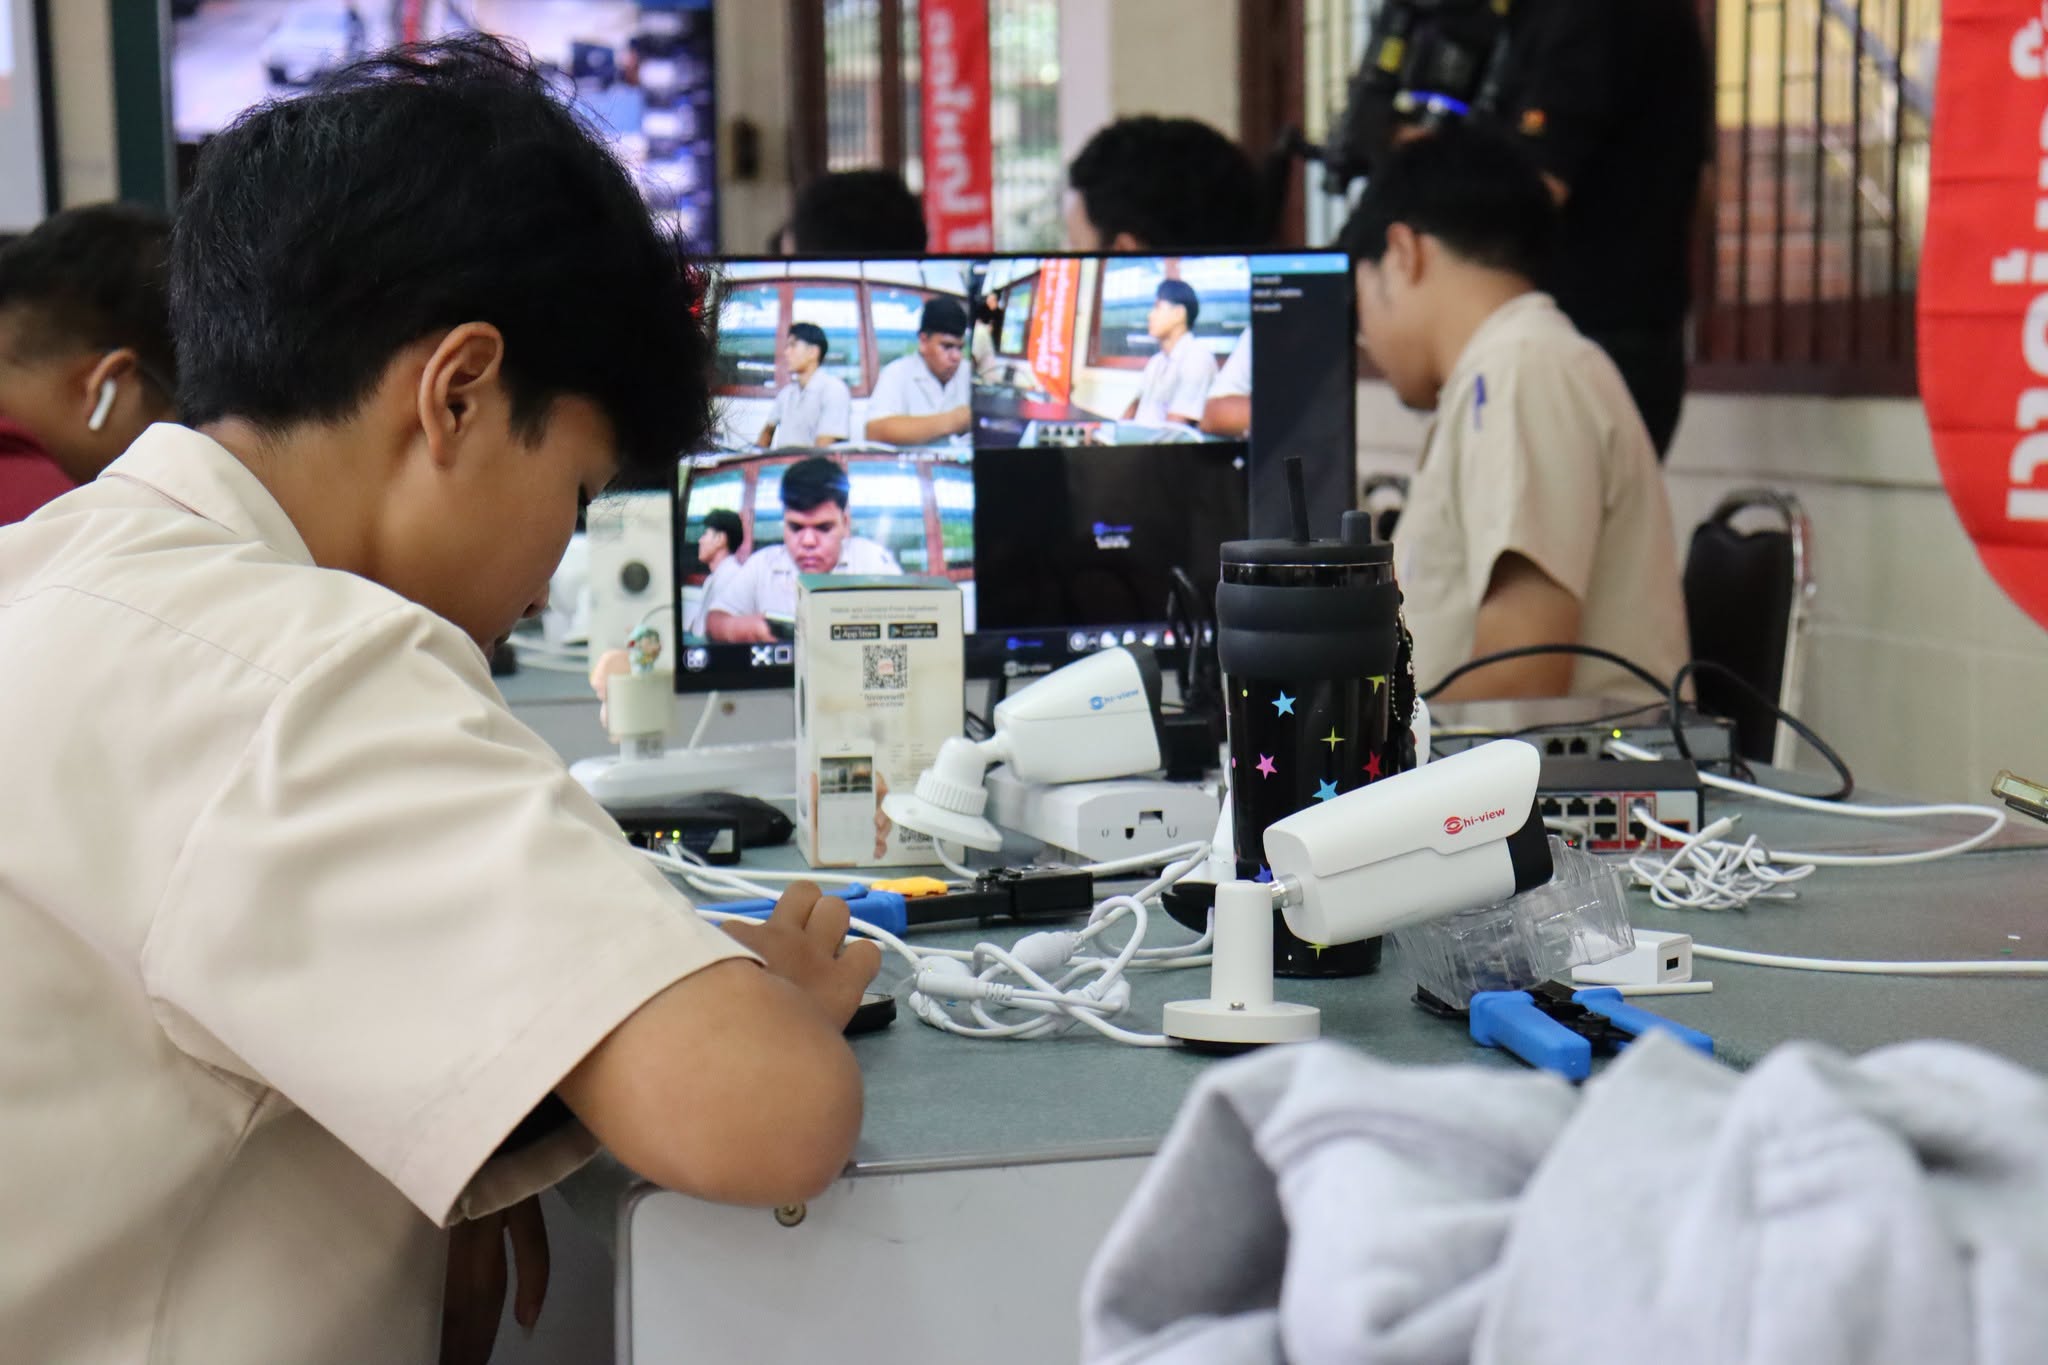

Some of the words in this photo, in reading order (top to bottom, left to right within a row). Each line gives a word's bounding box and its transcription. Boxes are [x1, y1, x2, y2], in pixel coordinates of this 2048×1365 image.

[842, 630, 858, 639] App
[858, 630, 878, 638] Store
[1103, 688, 1139, 703] hi-view
[1463, 807, 1506, 828] hi-view
